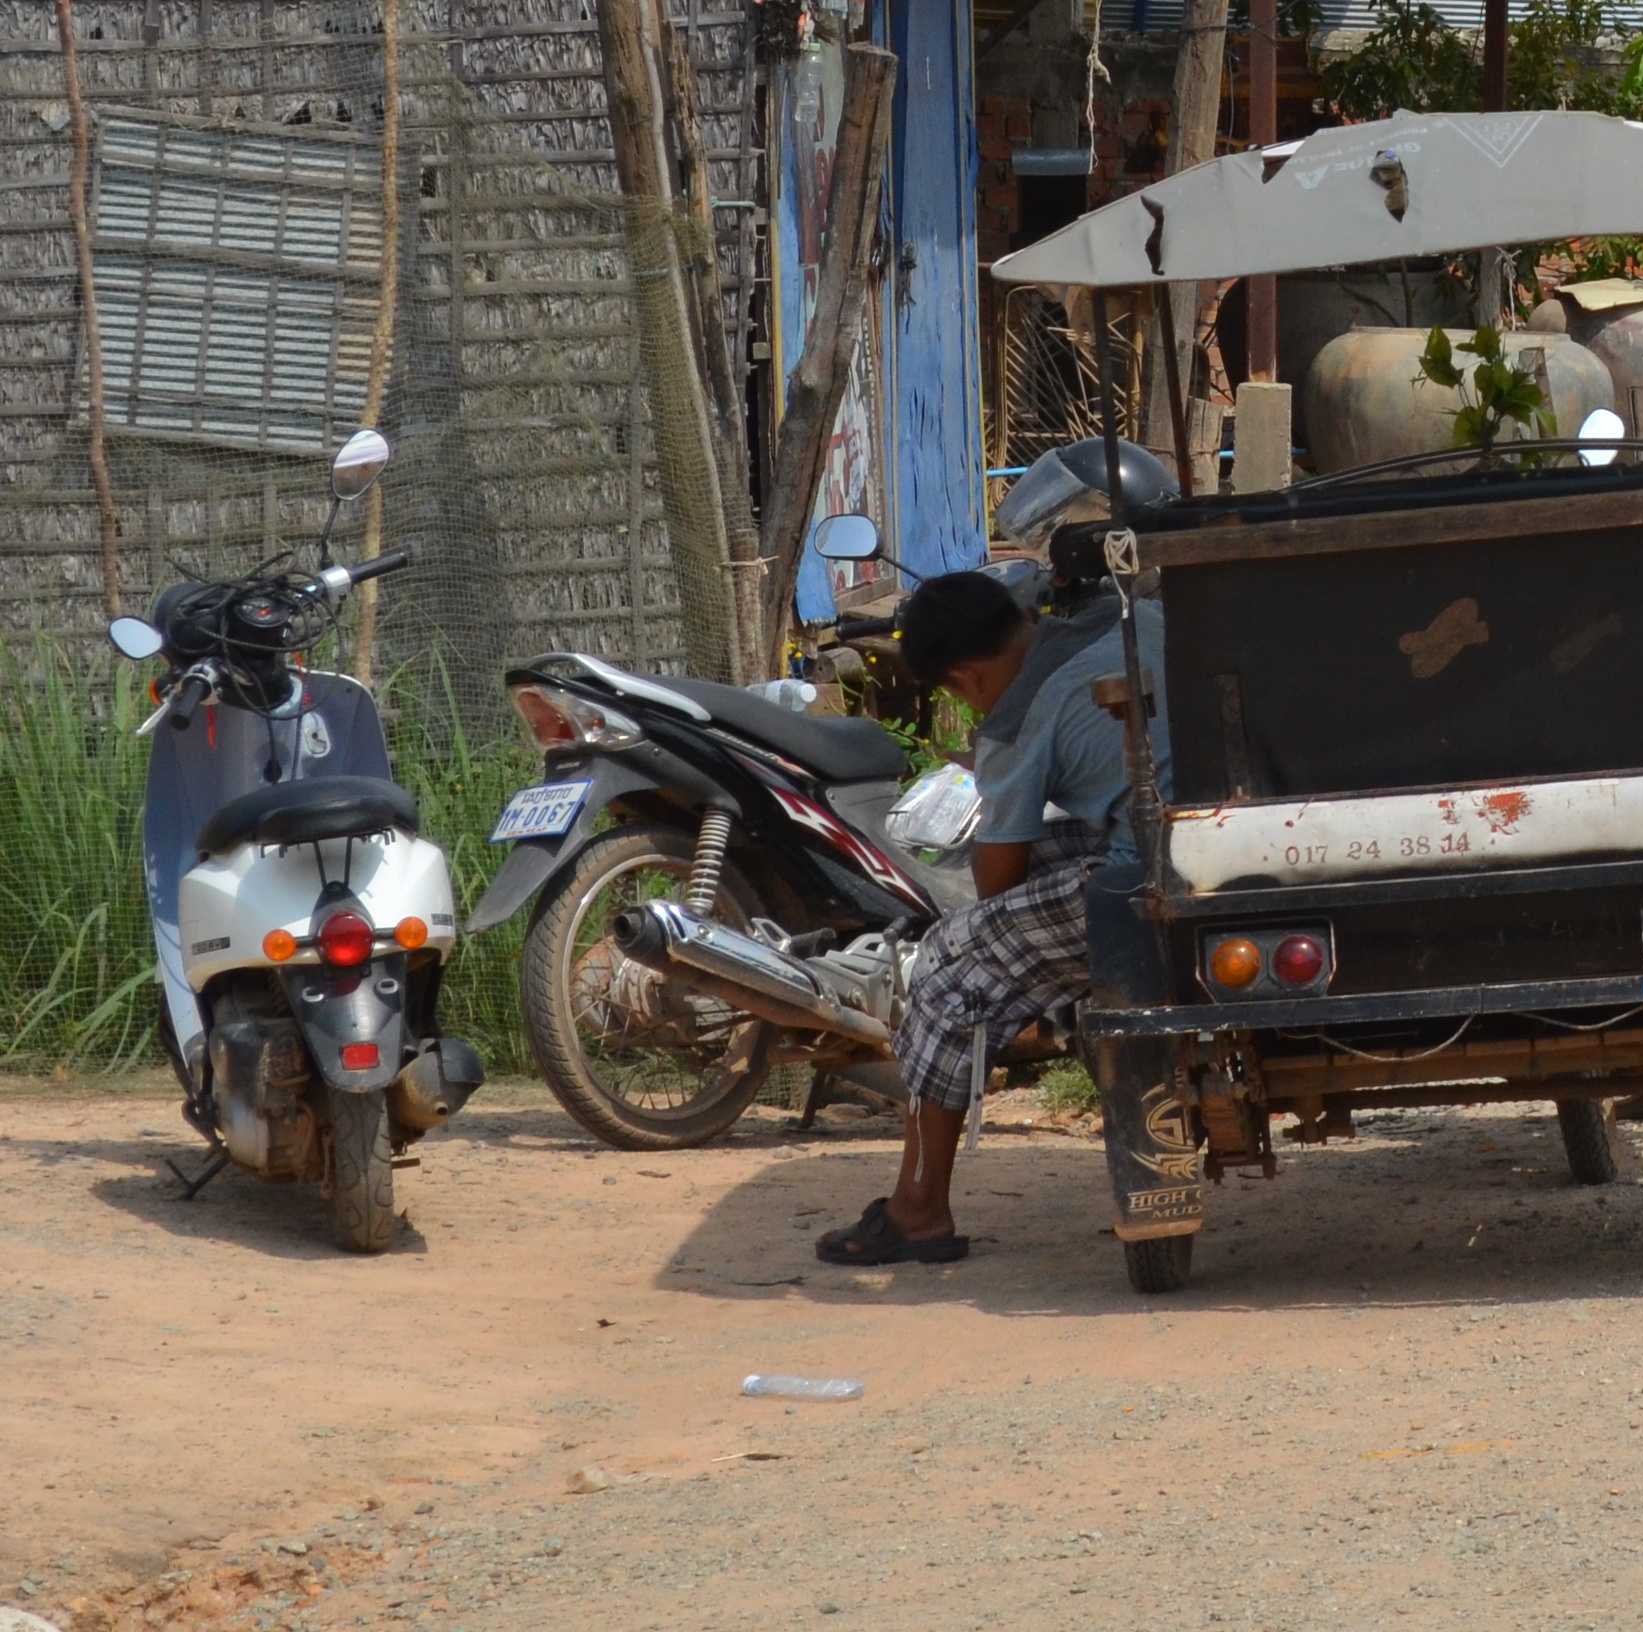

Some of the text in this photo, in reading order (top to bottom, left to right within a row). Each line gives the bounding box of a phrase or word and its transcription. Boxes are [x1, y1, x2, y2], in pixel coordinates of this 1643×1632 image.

[1285, 844, 1329, 866] 017
[1346, 840, 1382, 860] 24
[1400, 836, 1431, 857] 38
[1129, 1189, 1187, 1209] HIGH
